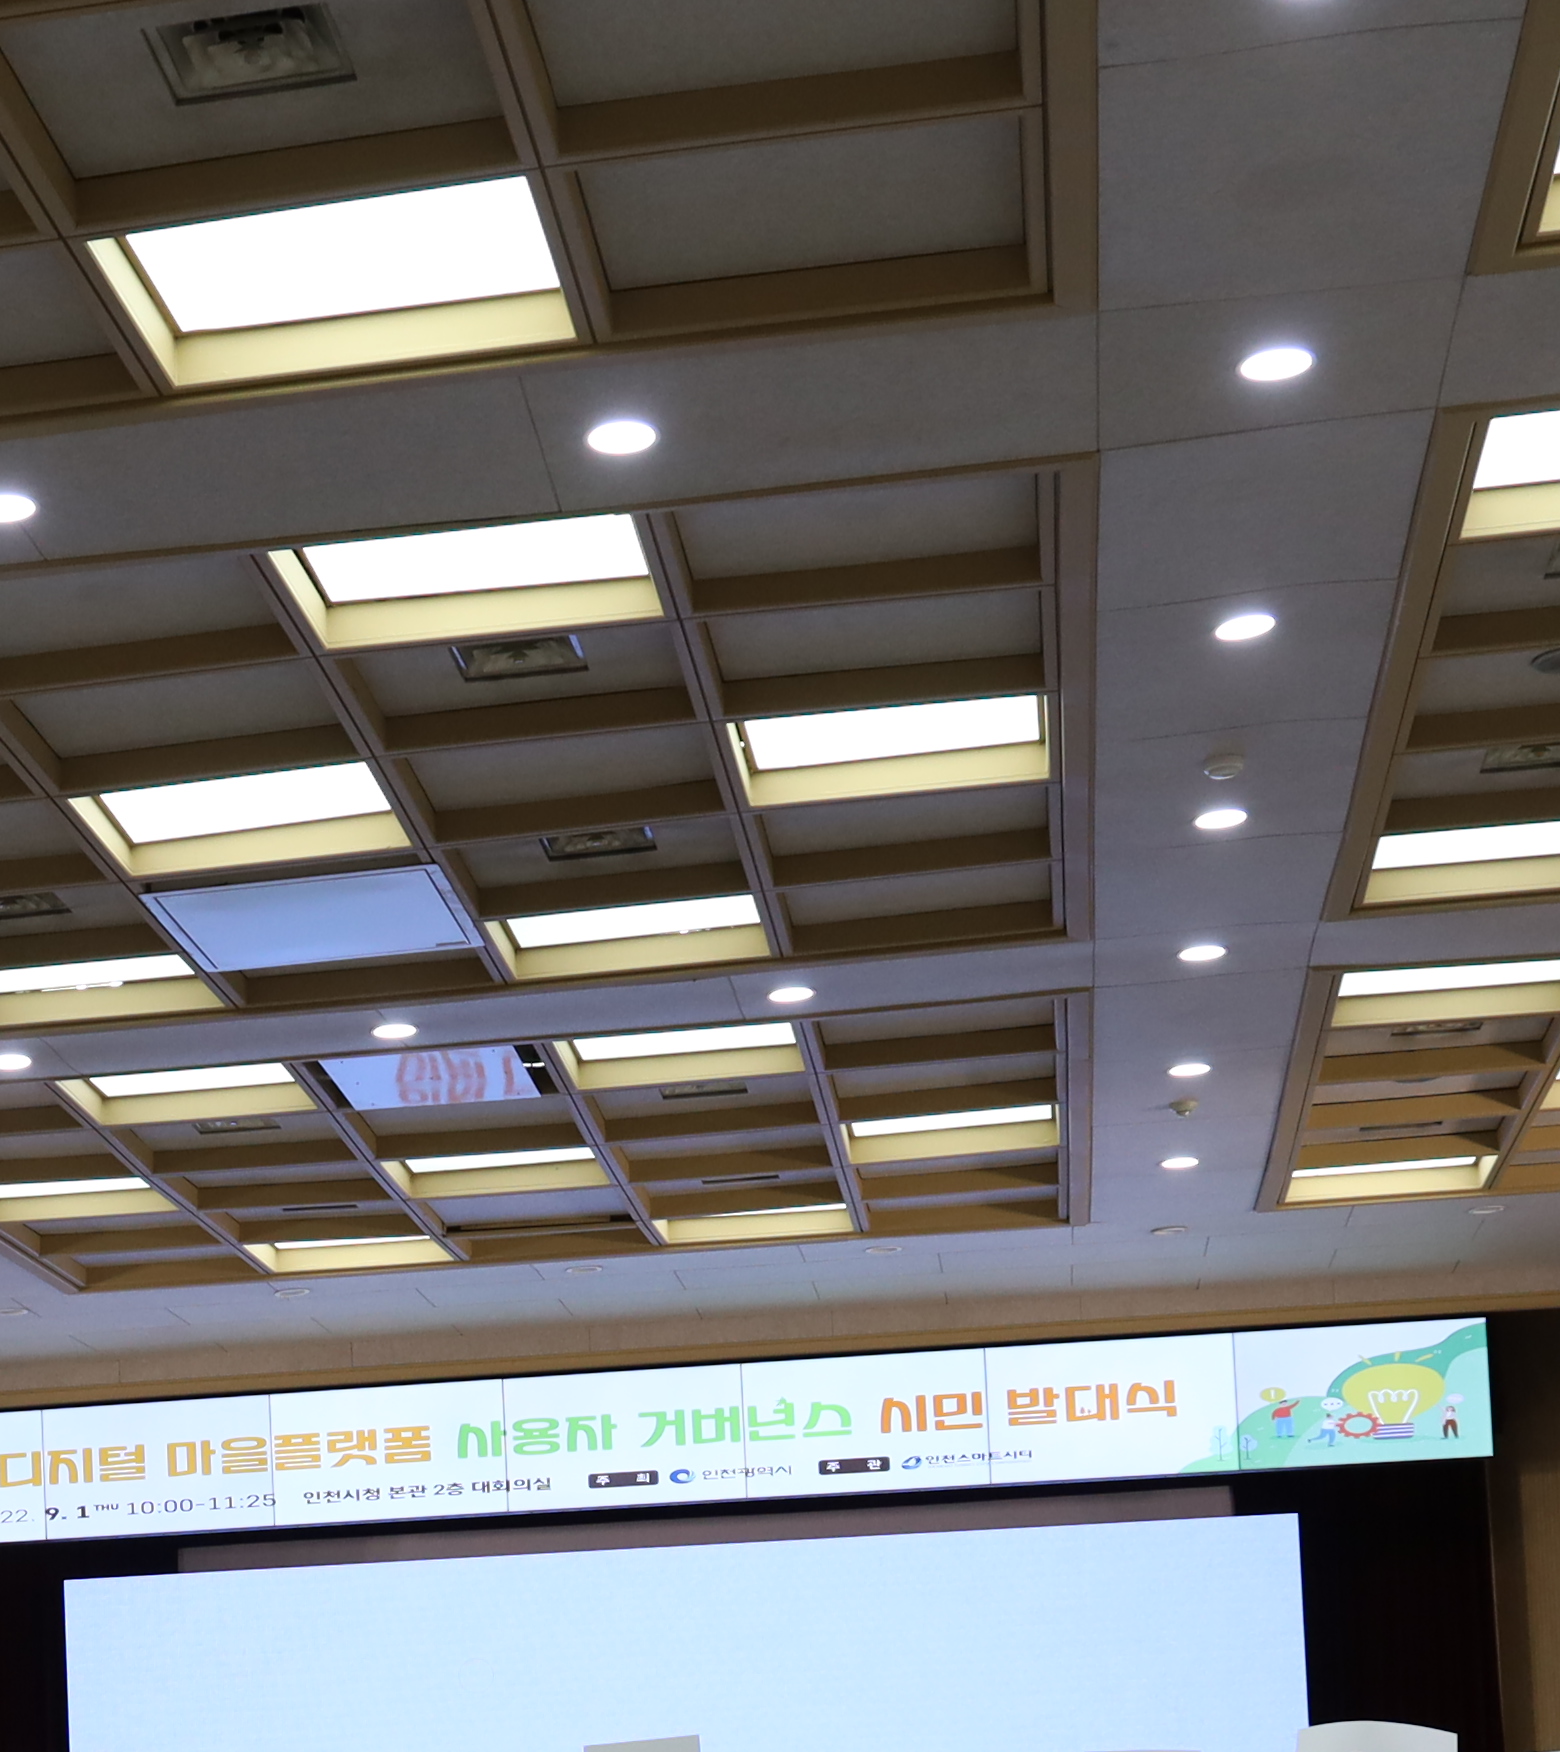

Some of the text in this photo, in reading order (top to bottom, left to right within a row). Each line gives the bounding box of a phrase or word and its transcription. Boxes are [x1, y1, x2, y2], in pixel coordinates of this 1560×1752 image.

[167, 1425, 432, 1478] 마을플랫폼
[458, 1413, 617, 1460] 사용자
[639, 1398, 853, 1448] 거버넌스
[881, 1391, 984, 1434] 시민
[1007, 1379, 1180, 1427] 발대식
[702, 1464, 792, 1481] 인천광역시
[93, 1503, 119, 1512] THU
[303, 1487, 381, 1504] 인천시청
[388, 1484, 427, 1499] 본관
[433, 1482, 465, 1496] 2층
[471, 1477, 552, 1493] 대회의실
